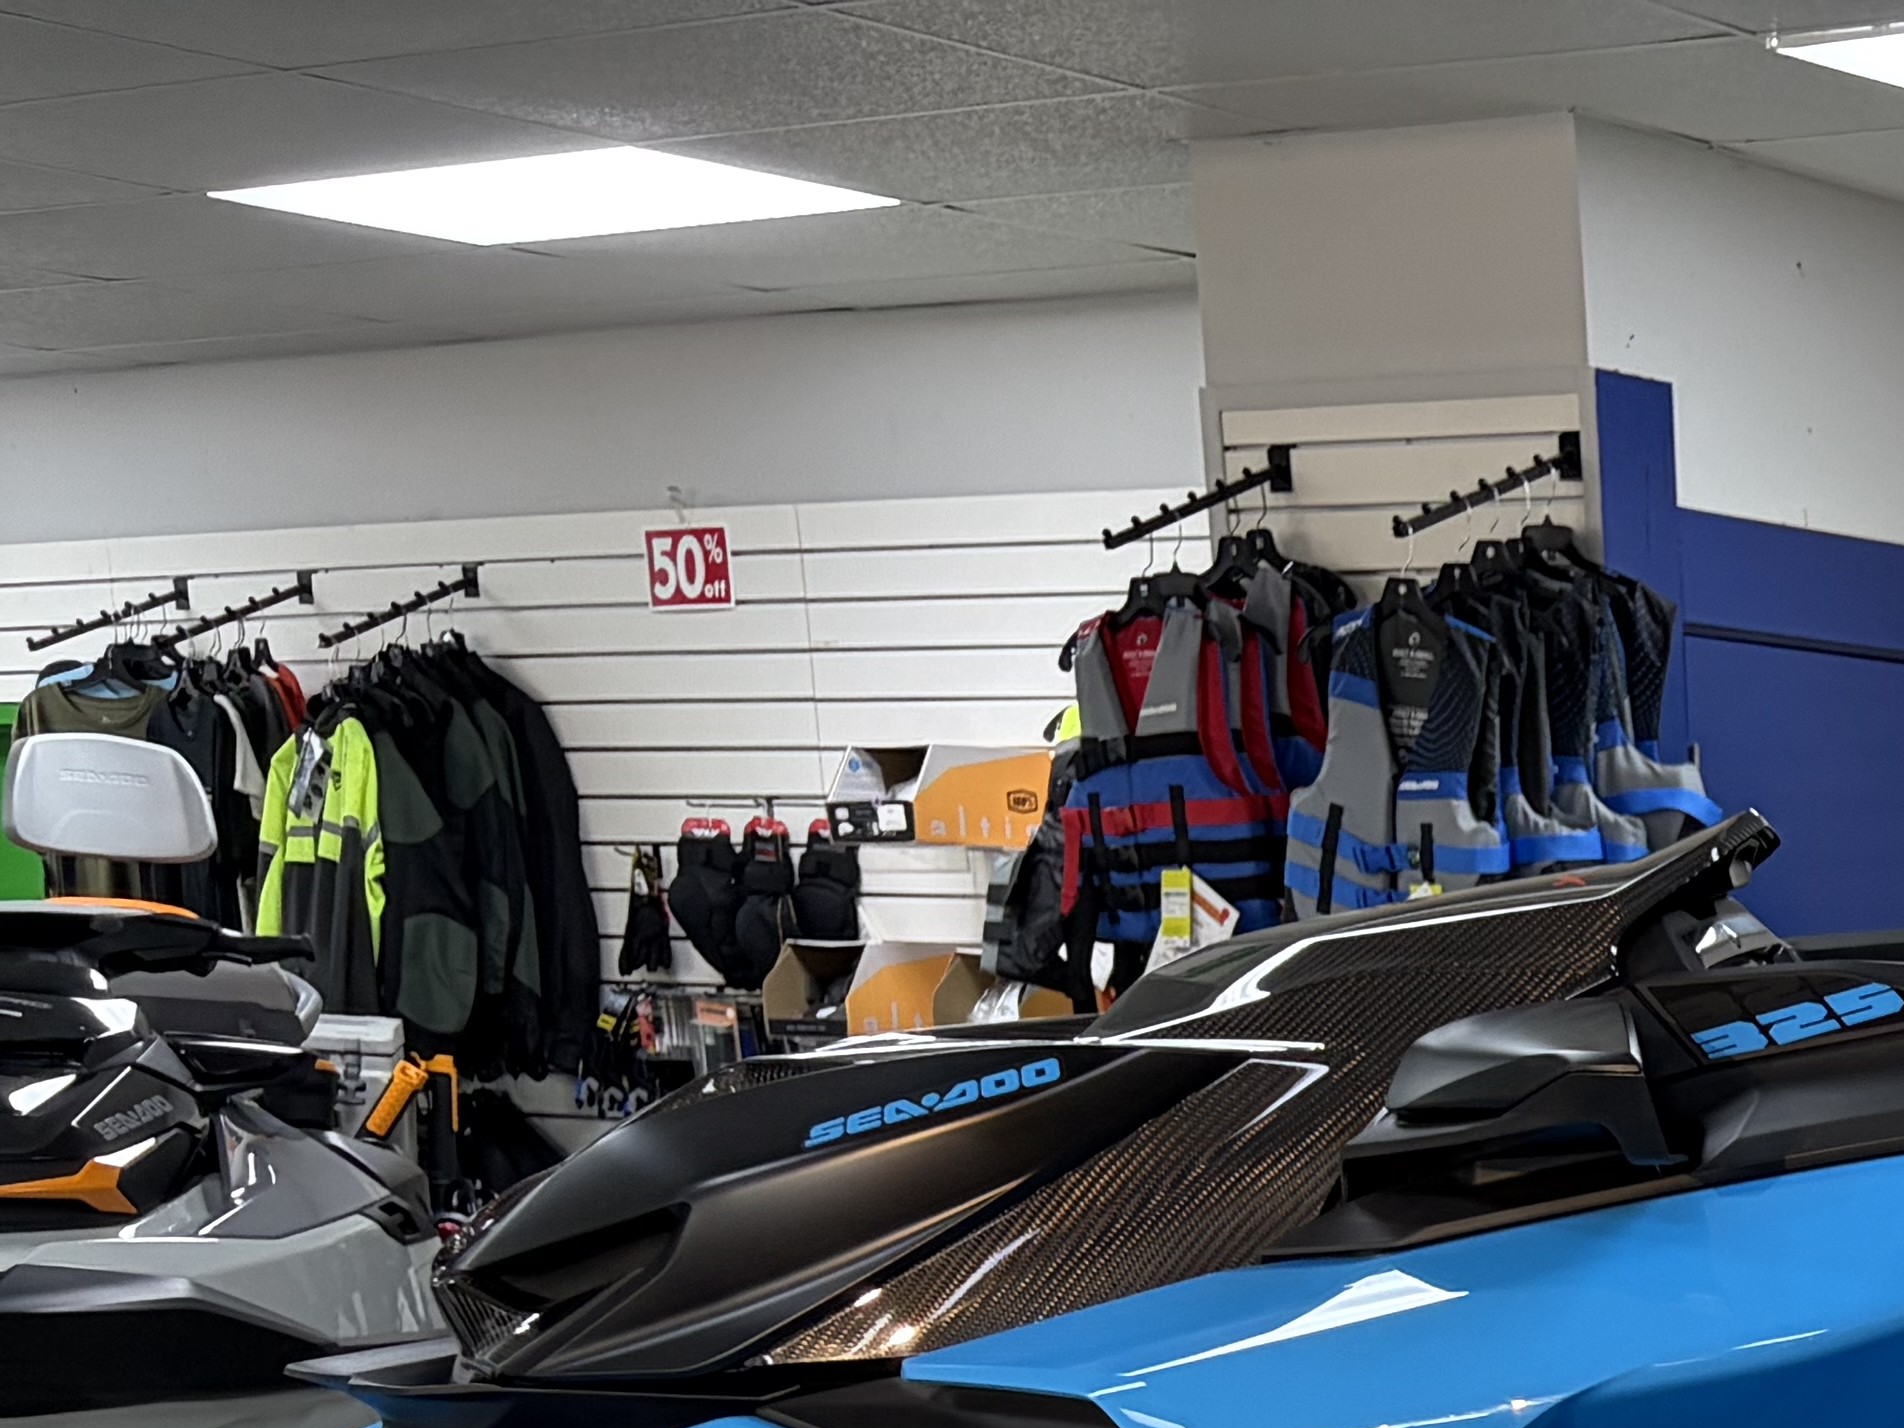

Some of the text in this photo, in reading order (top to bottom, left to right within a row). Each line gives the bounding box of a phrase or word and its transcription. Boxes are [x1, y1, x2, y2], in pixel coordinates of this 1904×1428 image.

[652, 532, 723, 600] 50%
[704, 579, 726, 599] off
[1691, 982, 1904, 1060] 325
